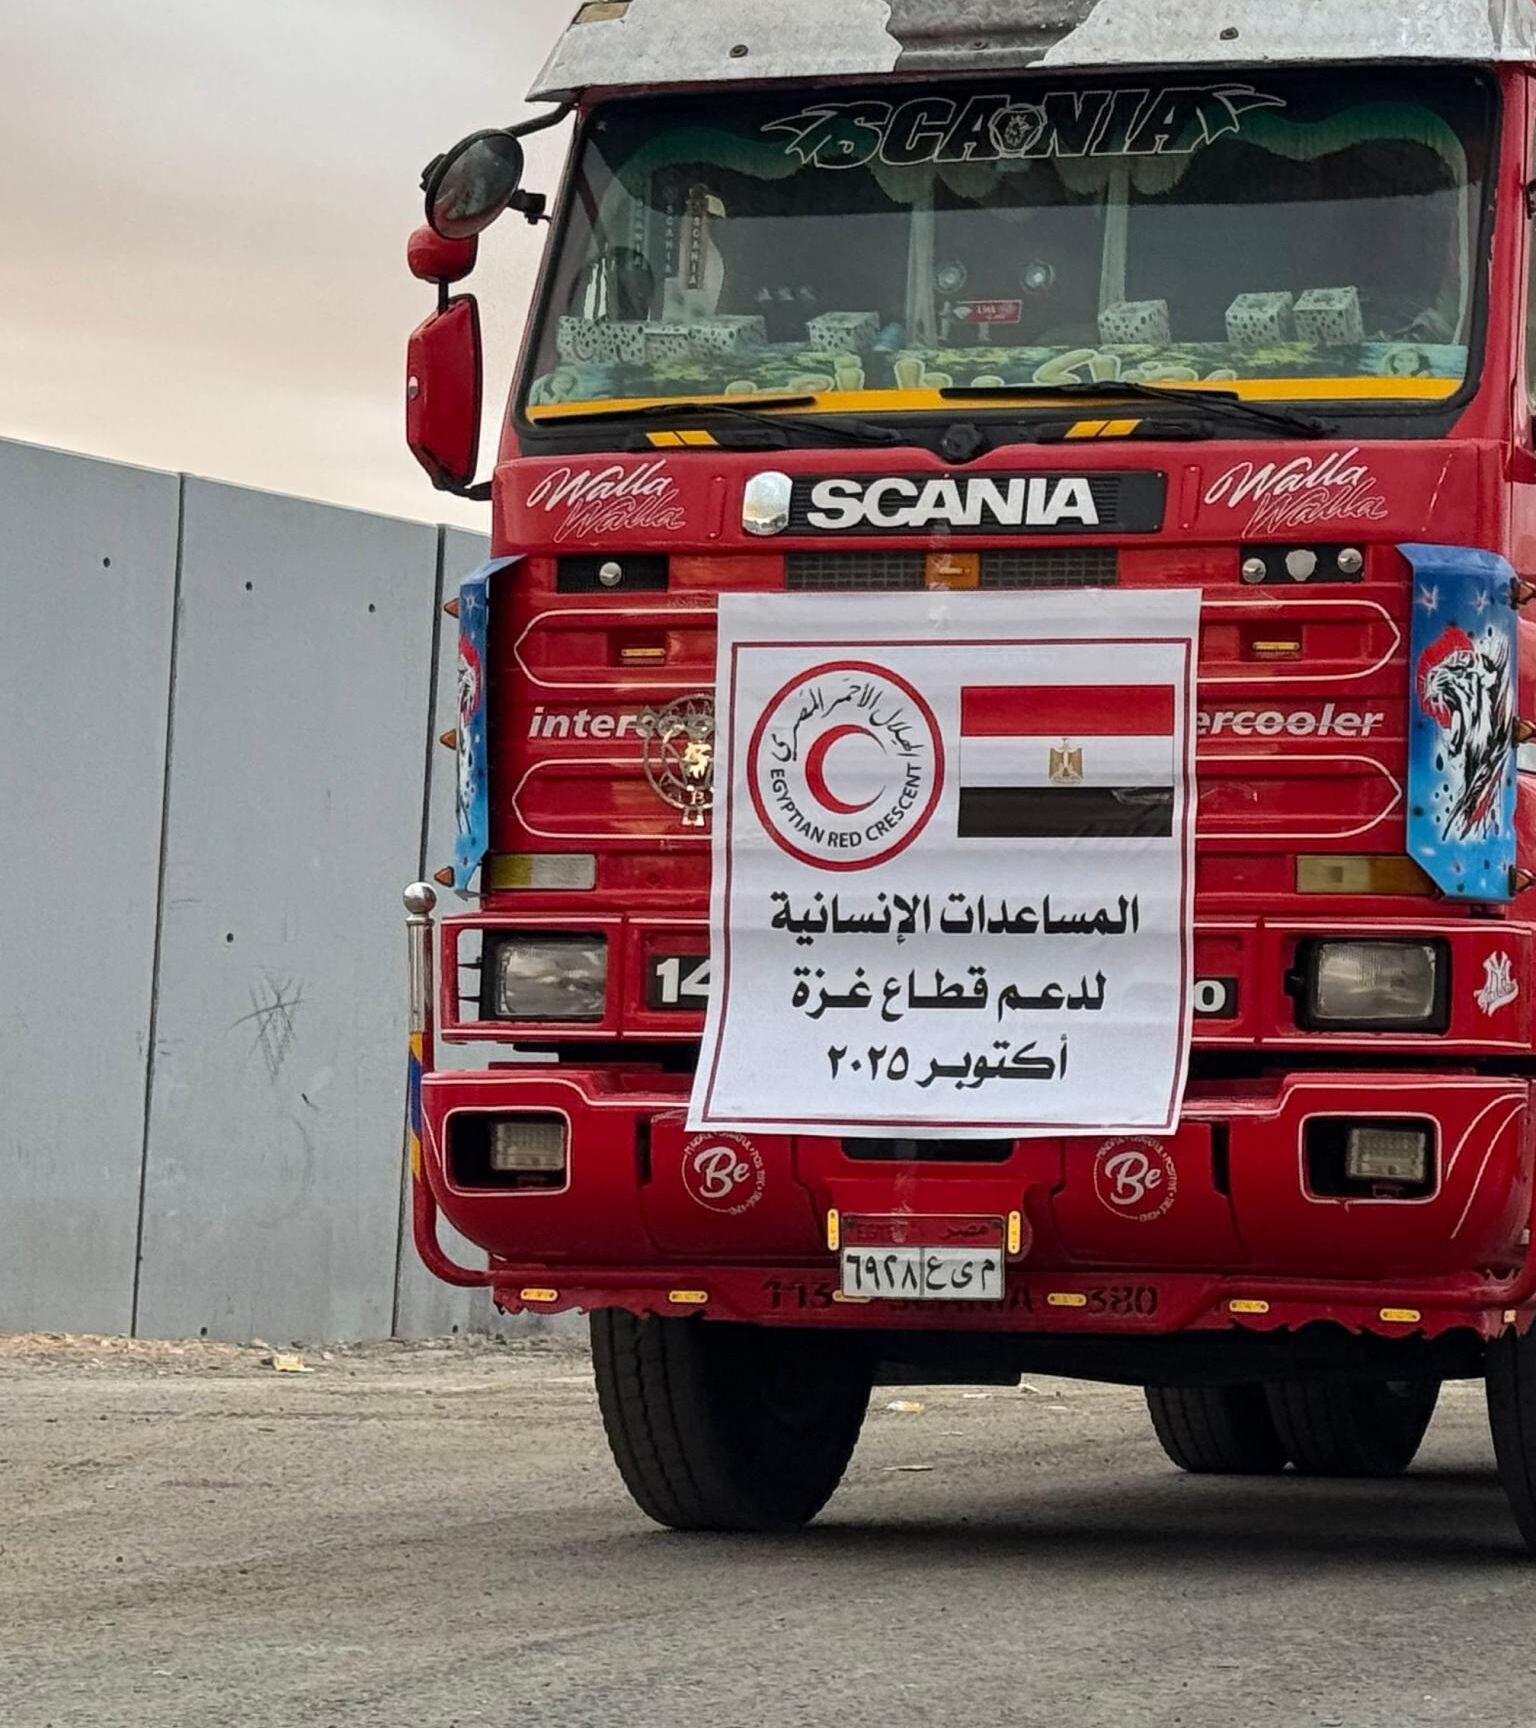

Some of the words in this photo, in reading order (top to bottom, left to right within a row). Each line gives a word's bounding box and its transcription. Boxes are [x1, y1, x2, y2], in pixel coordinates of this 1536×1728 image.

[780, 84, 1245, 168] SCANIA
[689, 217, 700, 284] SCANIA
[526, 458, 673, 511] Walla
[806, 478, 1099, 528] SCANIA
[1204, 446, 1368, 508] Walla
[1196, 703, 1384, 736] ercooler
[770, 768, 825, 843] EGYPTIAN
[827, 831, 862, 848] RED
[865, 762, 922, 841] CRESCENT
[771, 892, 930, 945] الإنسانية
[940, 894, 1138, 935] المساعدات
[655, 957, 711, 1003] 14
[793, 967, 871, 1019] غزة
[882, 967, 988, 1021] قطاع
[999, 971, 1106, 1021] لدعم
[828, 1046, 908, 1080] ٢٠٢٥
[917, 1034, 1066, 1089] أكتوبر
[694, 1146, 750, 1198] Be
[1105, 1151, 1162, 1204] Be
